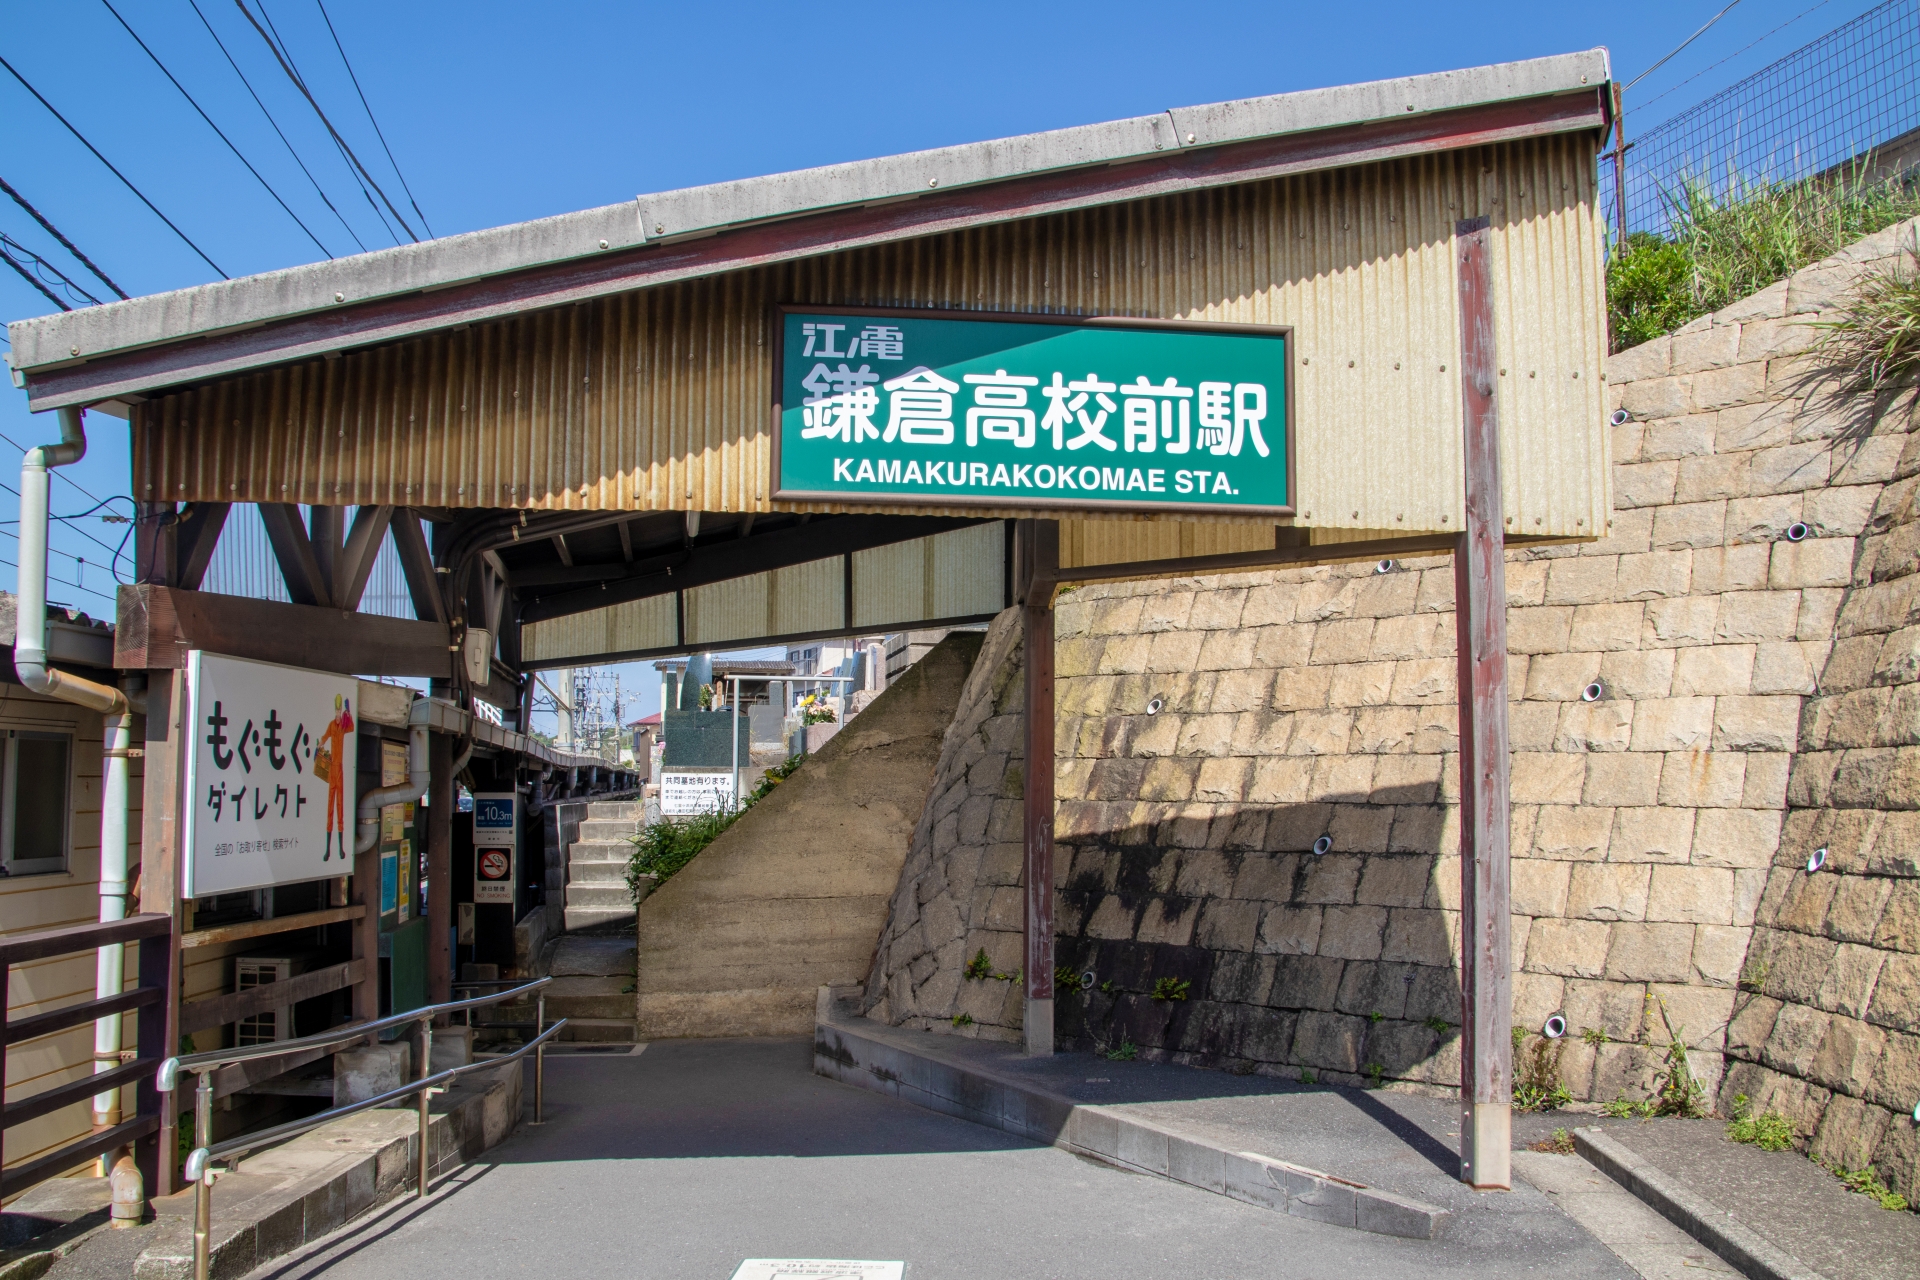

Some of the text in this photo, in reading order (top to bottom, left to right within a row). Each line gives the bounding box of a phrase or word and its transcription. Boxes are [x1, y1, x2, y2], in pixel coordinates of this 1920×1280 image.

[802, 323, 903, 360] 江ノ電
[801, 362, 1270, 458] 鎌倉高校前駅
[833, 458, 1240, 495] KAMAKURAKOKOMAE STA.
[207, 701, 310, 774] もぐもぐ
[207, 781, 307, 823] ダイレクト
